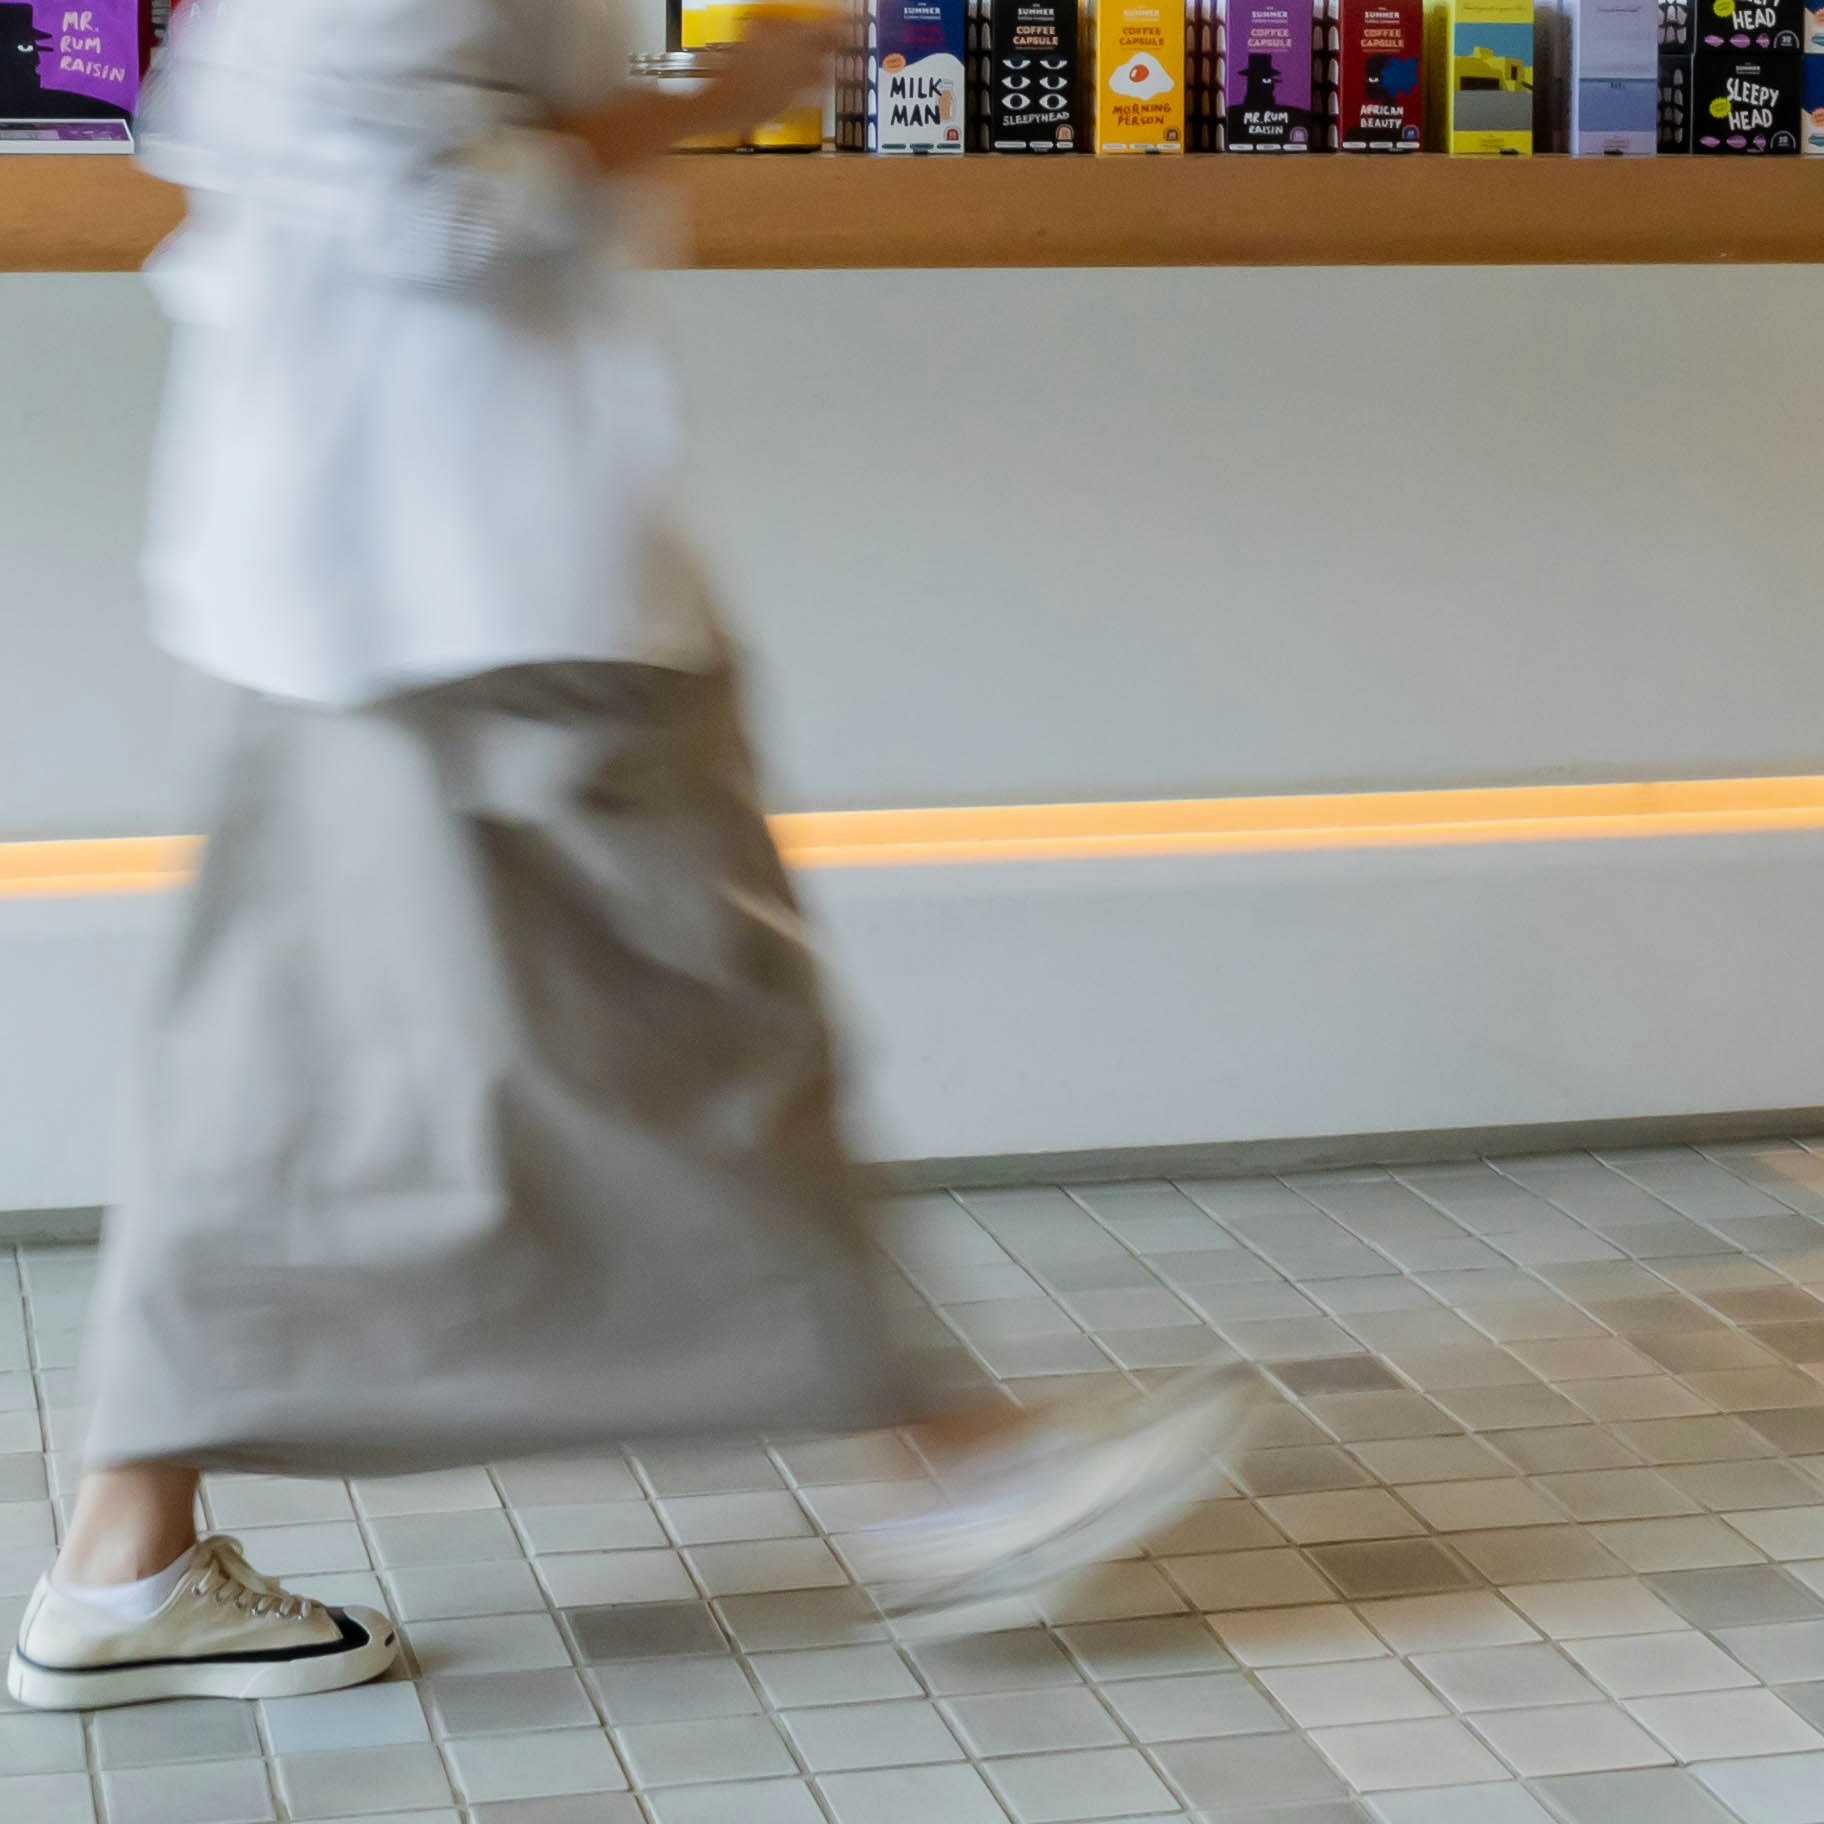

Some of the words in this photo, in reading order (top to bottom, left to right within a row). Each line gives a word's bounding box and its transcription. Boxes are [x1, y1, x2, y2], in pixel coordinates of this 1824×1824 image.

[62, 10, 100, 33] MR.
[1731, 8, 1777, 30] HEAD
[1016, 26, 1056, 35] COFFEE
[60, 34, 101, 54] RUM
[1012, 36, 1059, 46] CAPSULE
[1360, 38, 1404, 48] CAPSULE
[60, 55, 126, 83] RAISIN
[889, 76, 943, 99] MILK
[1726, 77, 1780, 107] SLEEPY
[890, 103, 941, 126] MAN
[1112, 102, 1172, 116] MORNING
[1360, 104, 1405, 116] AFRICAN
[1002, 111, 1070, 127] SLEEPYHEAD
[1117, 115, 1165, 126] PERSON
[1243, 111, 1264, 125] MR.
[1264, 111, 1289, 124] RUM
[1360, 118, 1402, 129] BEAUTY
[1728, 108, 1773, 131] HEAD
[1248, 125, 1283, 135] RAISIN
